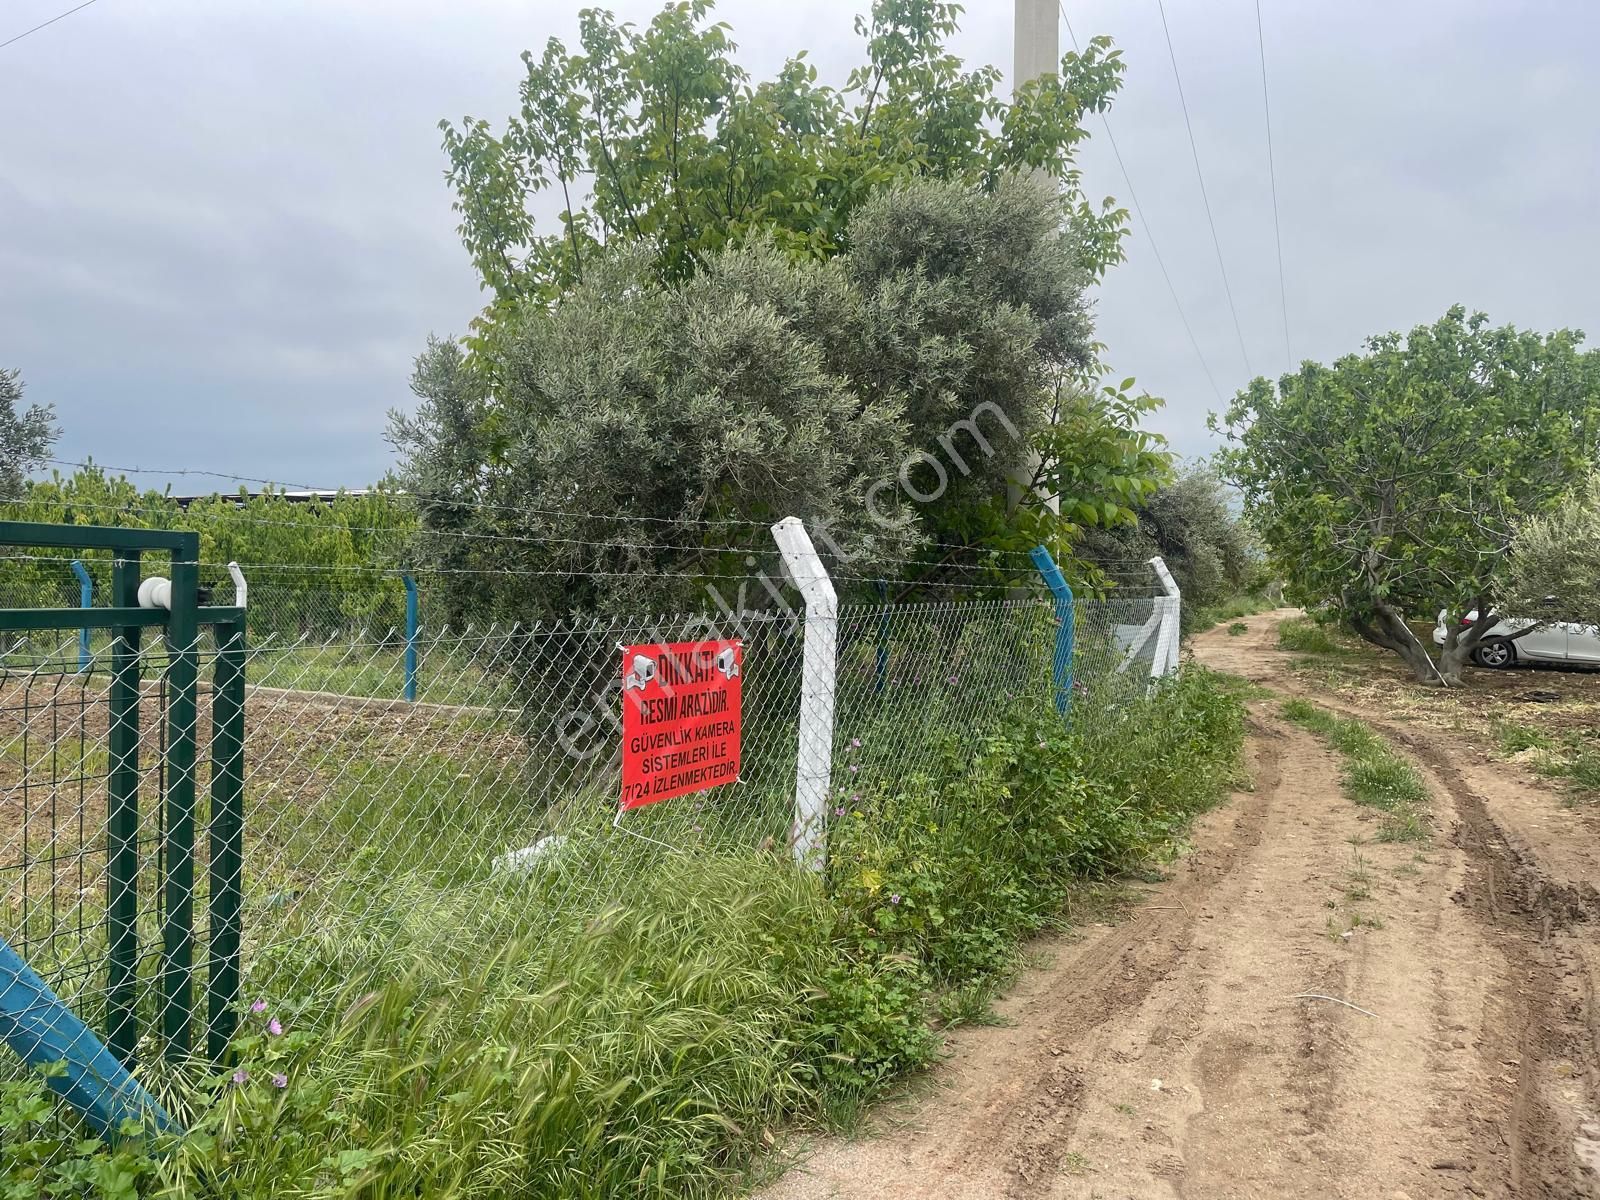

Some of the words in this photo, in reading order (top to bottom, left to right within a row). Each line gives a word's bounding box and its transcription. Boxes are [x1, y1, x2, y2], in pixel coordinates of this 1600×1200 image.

[658, 648, 714, 687] DİKKAT!
[640, 692, 679, 725] RESMİ
[680, 687, 729, 718] ARAZİDİR.
[631, 726, 692, 754] GÜVENLİK
[694, 721, 736, 740] KAMERA
[642, 742, 709, 774] SİSTEMLERİ
[711, 741, 727, 758] İLE
[624, 781, 650, 801] 7/24
[653, 760, 737, 795] İZLENMEKTEDİR.
